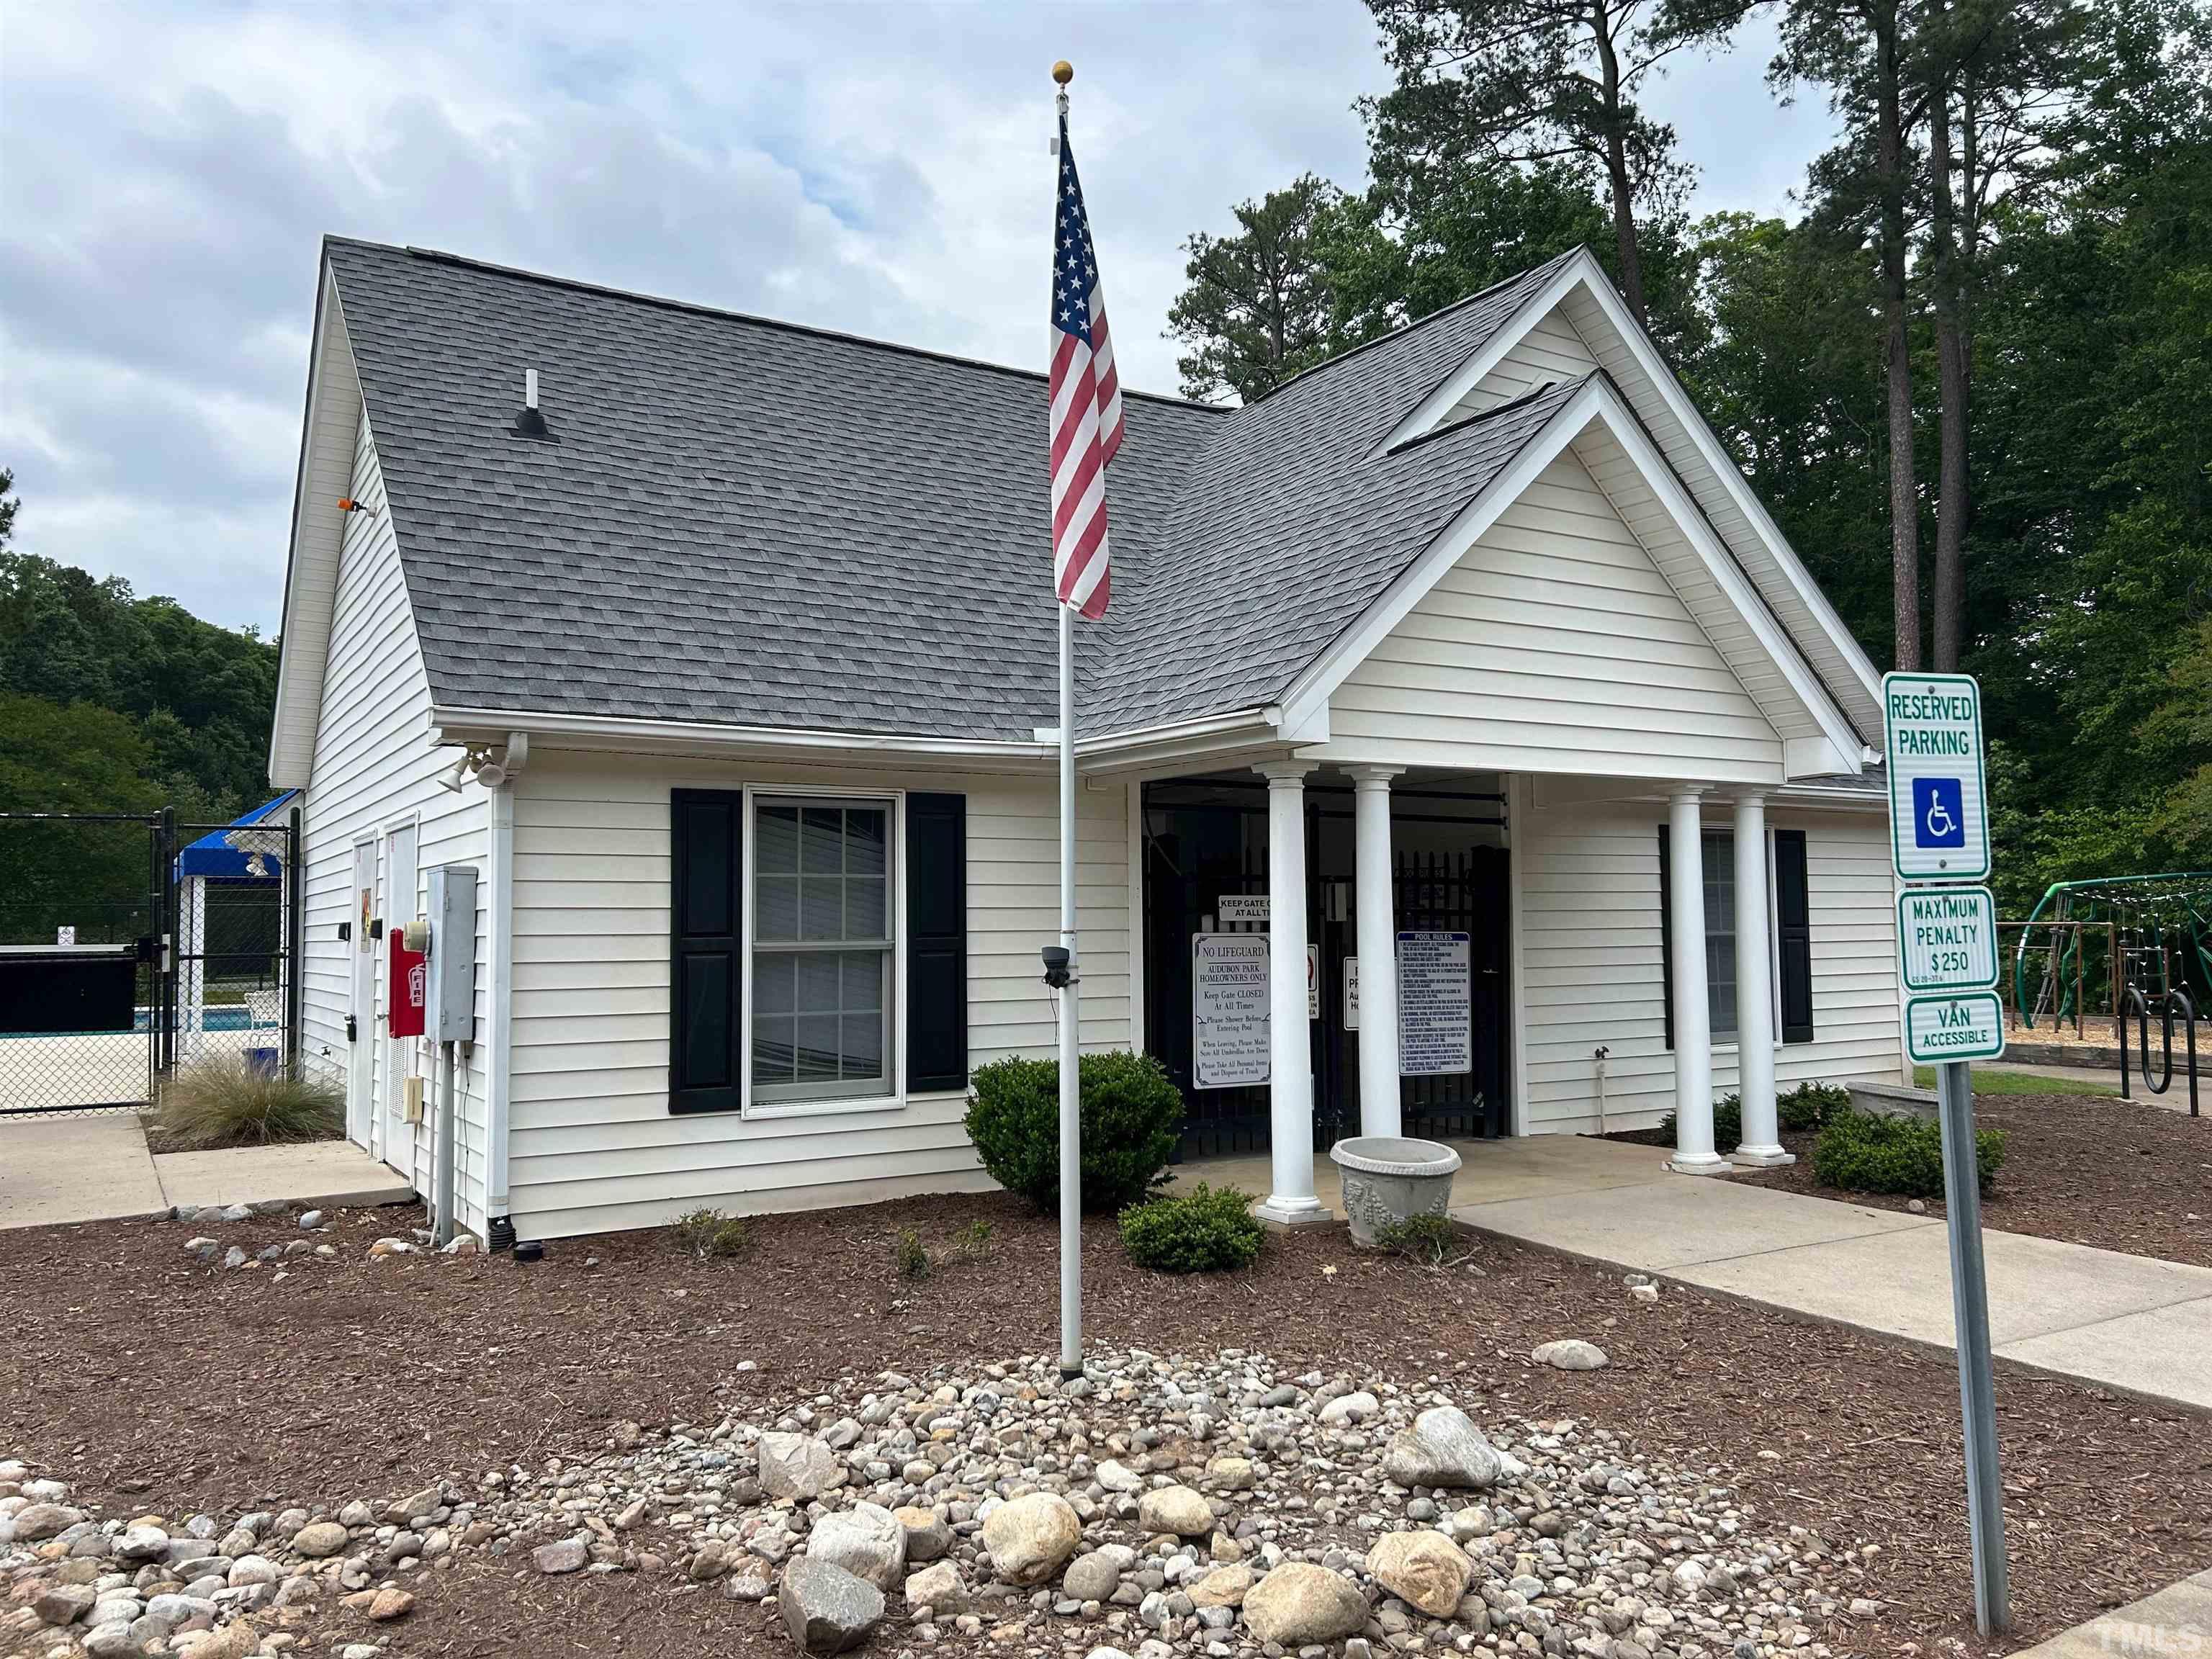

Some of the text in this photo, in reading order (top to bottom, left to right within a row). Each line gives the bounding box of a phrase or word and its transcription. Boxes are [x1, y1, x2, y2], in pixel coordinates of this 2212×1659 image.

[1892, 695, 1972, 720] RESERVED
[1899, 730, 1969, 755] PARKING
[1913, 899, 1978, 920] MAXIMUM
[1917, 925, 1977, 945] PENALTY
[1203, 947, 1264, 957] NO LIFEGUARD
[1932, 952, 1968, 972] $250
[1209, 964, 1260, 974] AUDUBON PARK
[413, 974, 422, 1003] FIRE
[1204, 991, 1219, 1002] Keep
[1938, 1007, 1970, 1028] VAN
[1923, 1030, 1988, 1047] ACCESSIBLE
